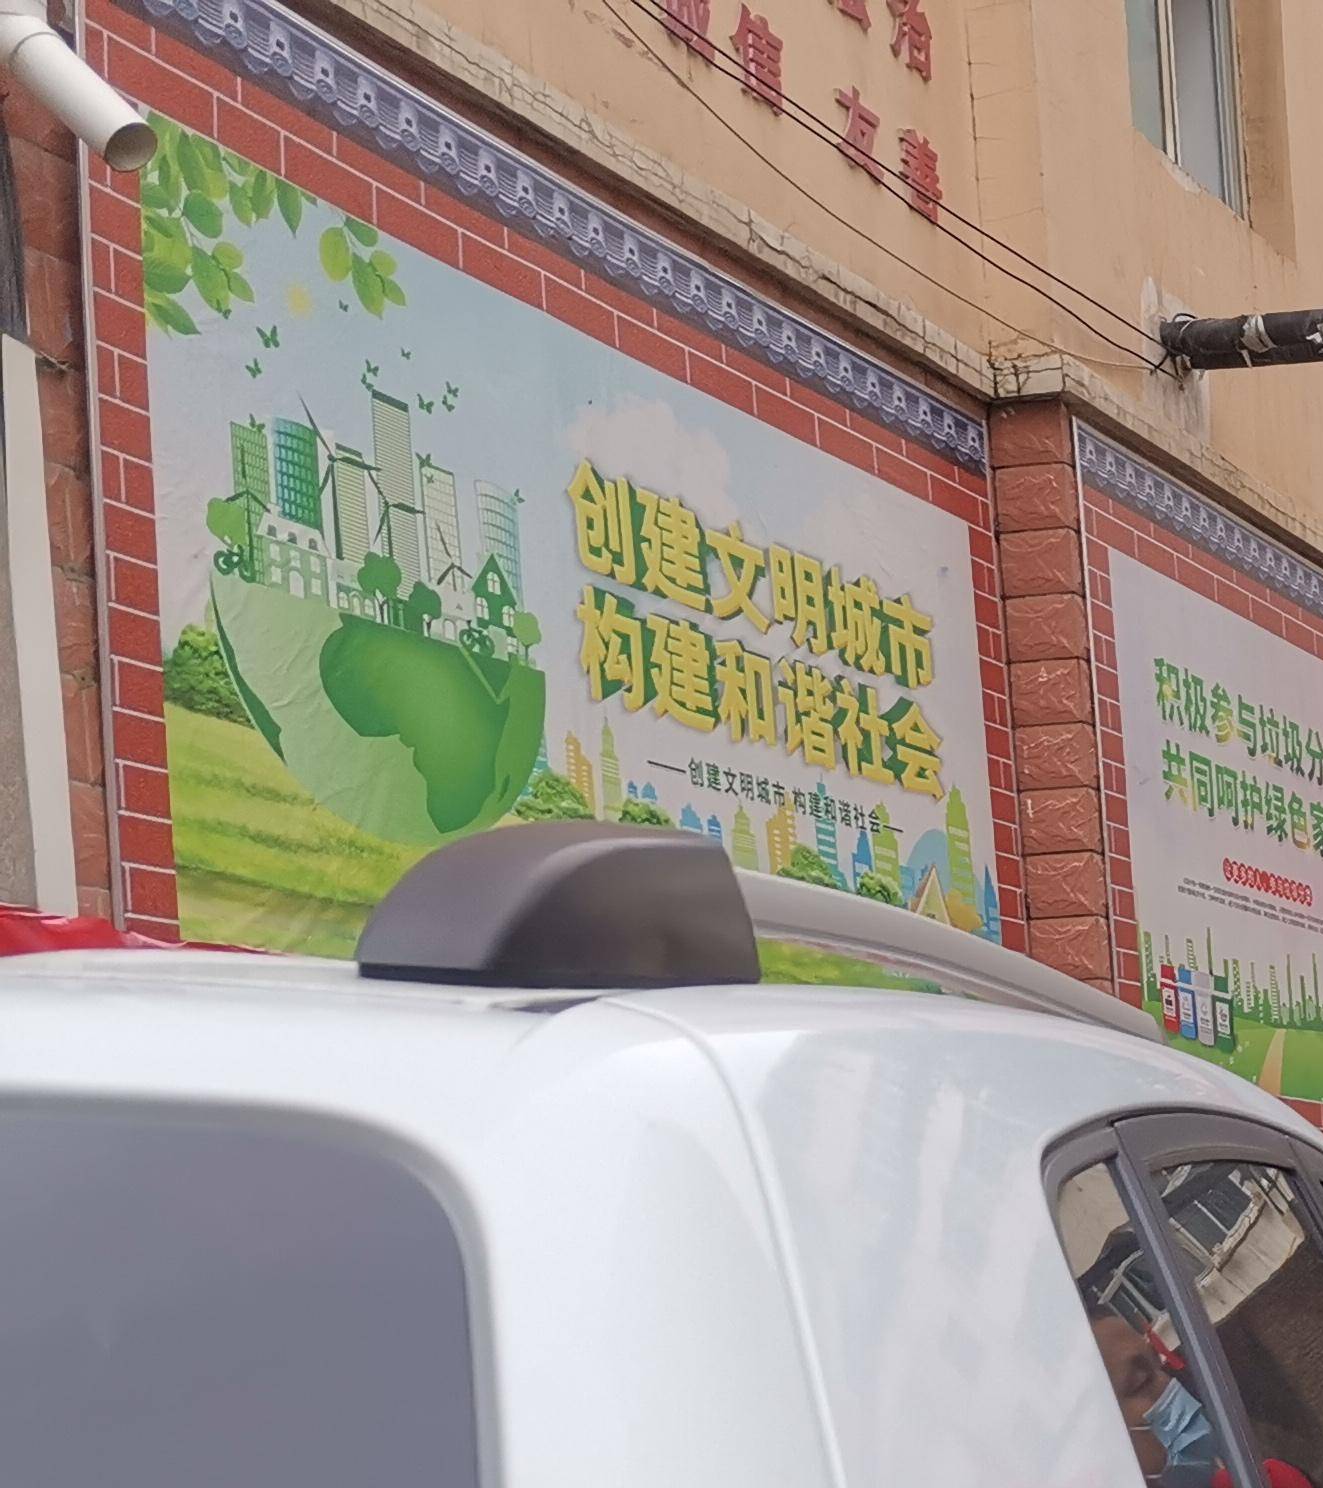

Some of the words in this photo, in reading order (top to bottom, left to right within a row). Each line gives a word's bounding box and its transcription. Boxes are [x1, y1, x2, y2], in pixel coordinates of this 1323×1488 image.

[567, 459, 935, 690] 创建文明城市
[576, 585, 946, 801] 构建和谐社会
